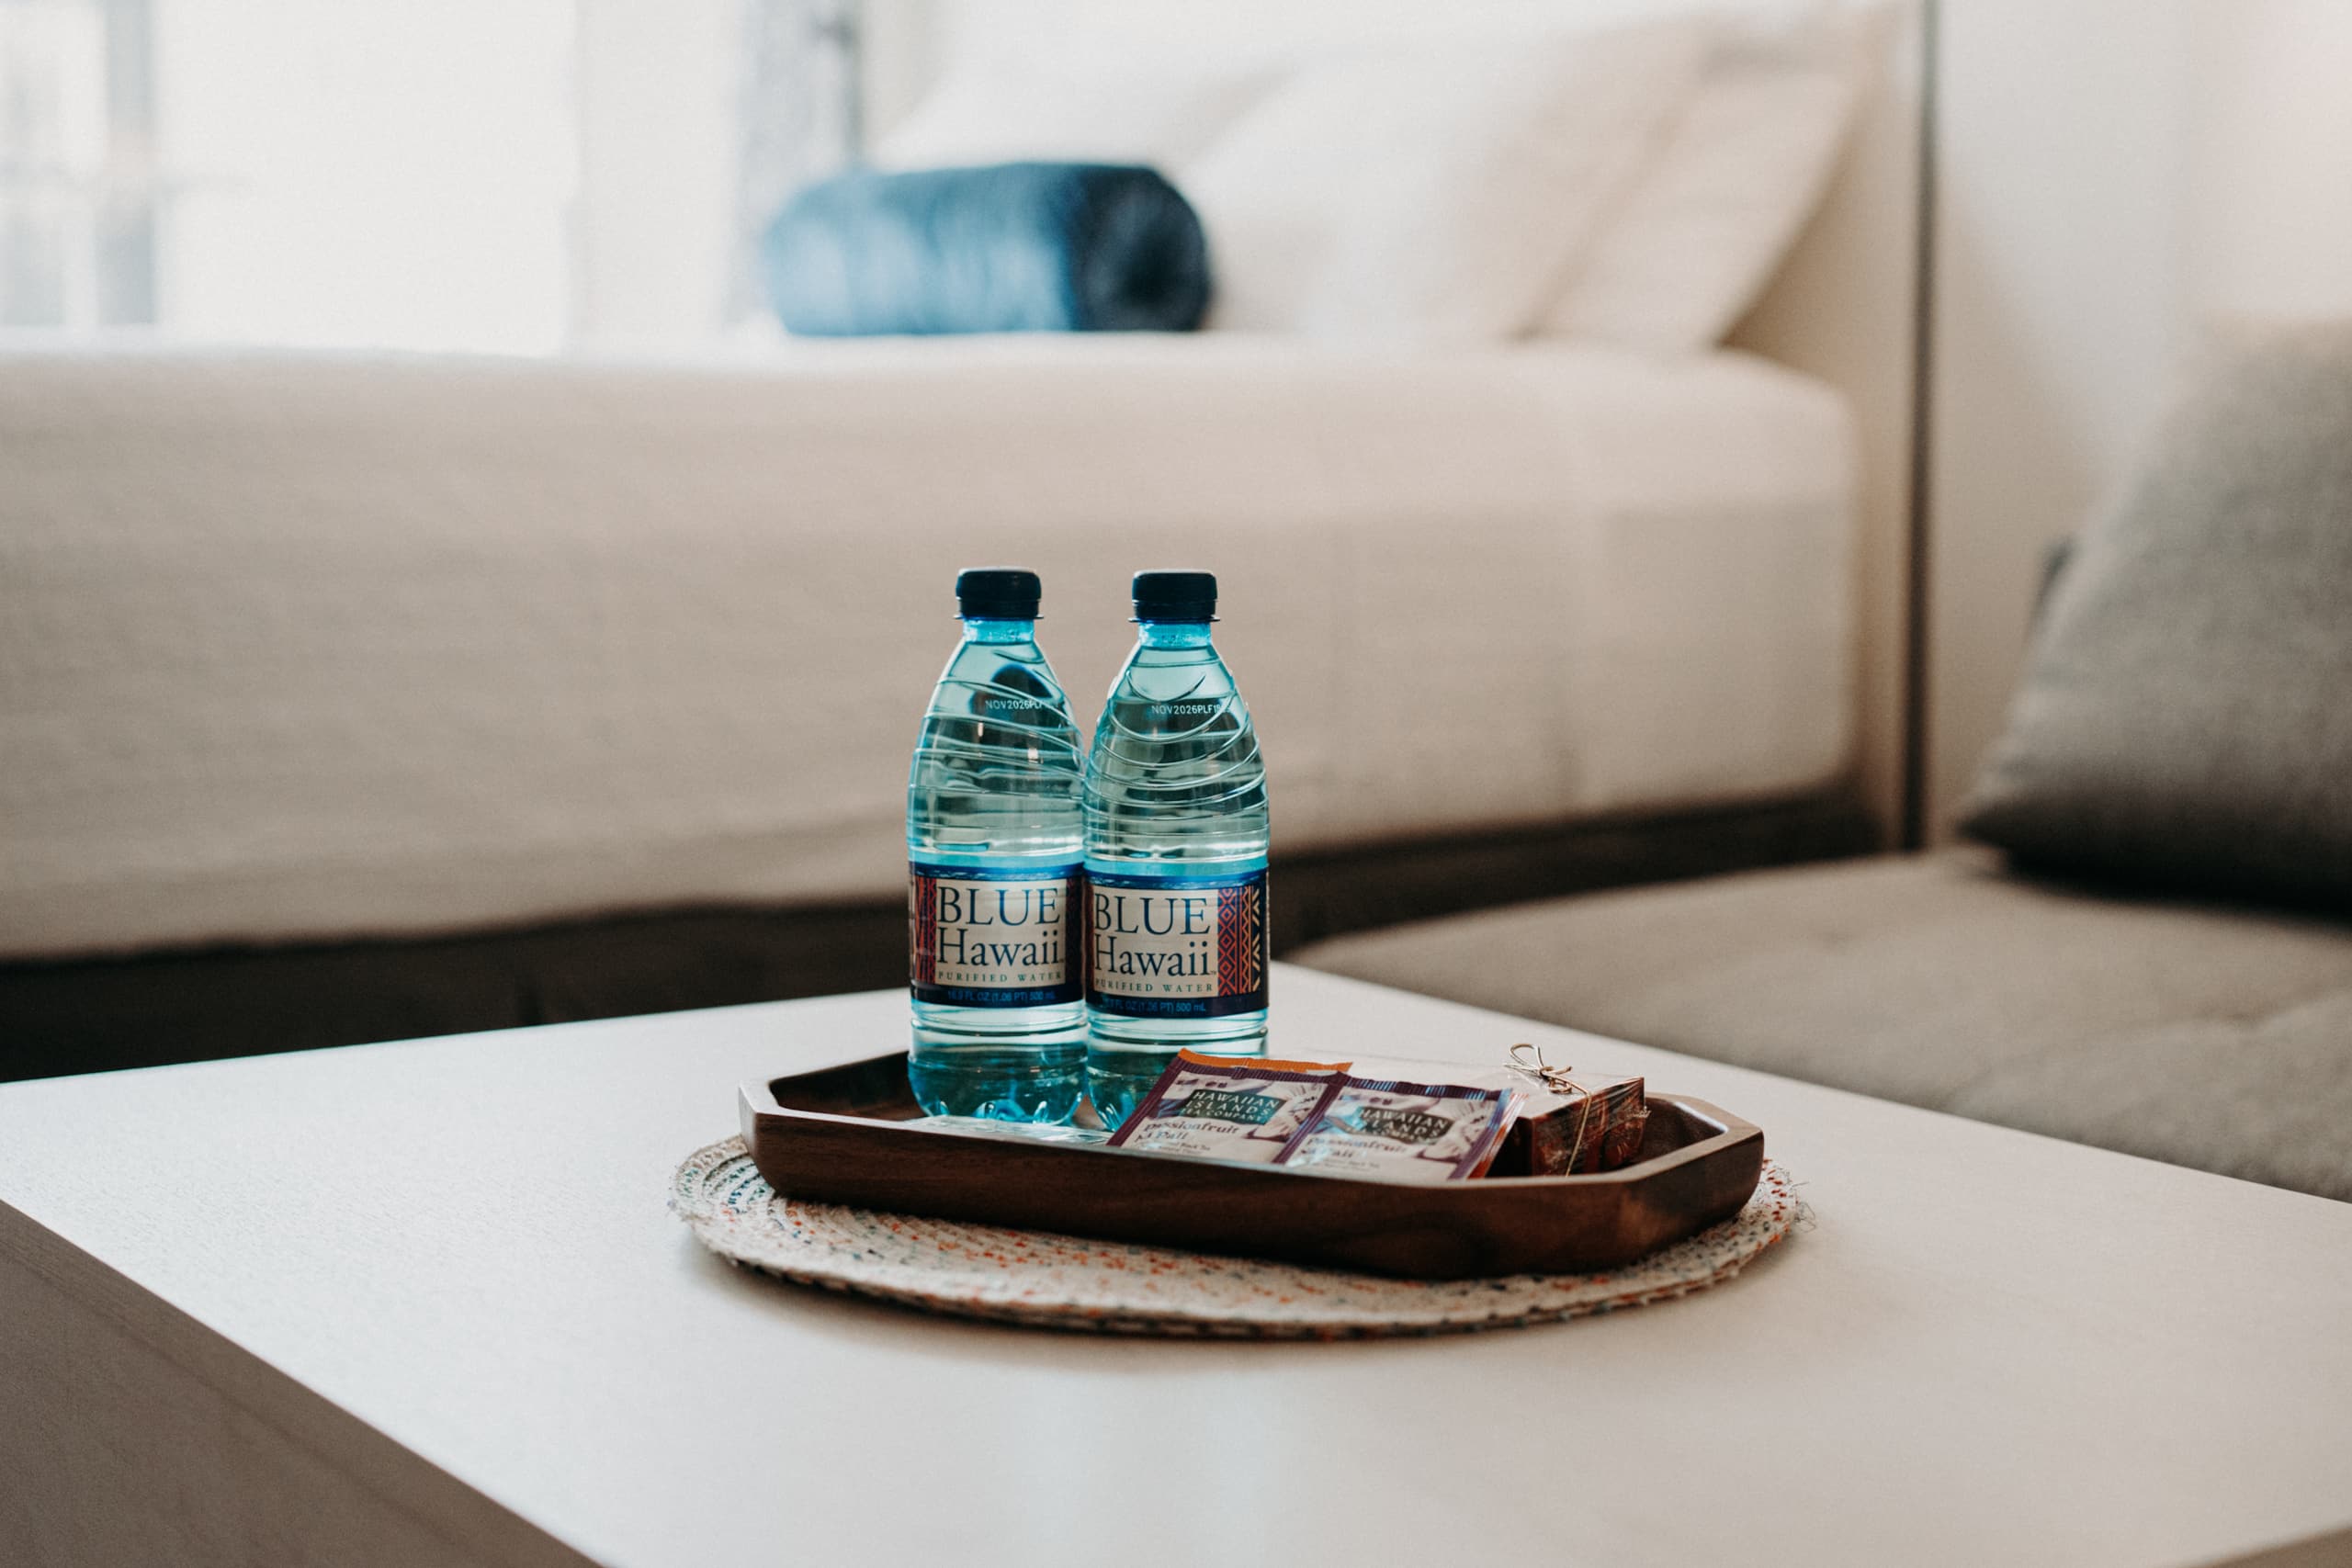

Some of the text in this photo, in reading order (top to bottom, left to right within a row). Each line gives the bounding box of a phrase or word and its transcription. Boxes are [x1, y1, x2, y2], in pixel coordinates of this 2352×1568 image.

[937, 886, 1060, 926] BLUE
[1094, 893, 1211, 935] BLUE
[937, 926, 1060, 966] Hawaii
[1094, 933, 1212, 976] Hawaii
[938, 971, 1062, 983] PURIFIED WATER
[1095, 978, 1213, 993] PURIFIED WATER
[1185, 1100, 1271, 1115] ISLANDS
[1193, 1091, 1279, 1108] HAWAIIAN
[1360, 1109, 1448, 1129] HAWAIIAN
